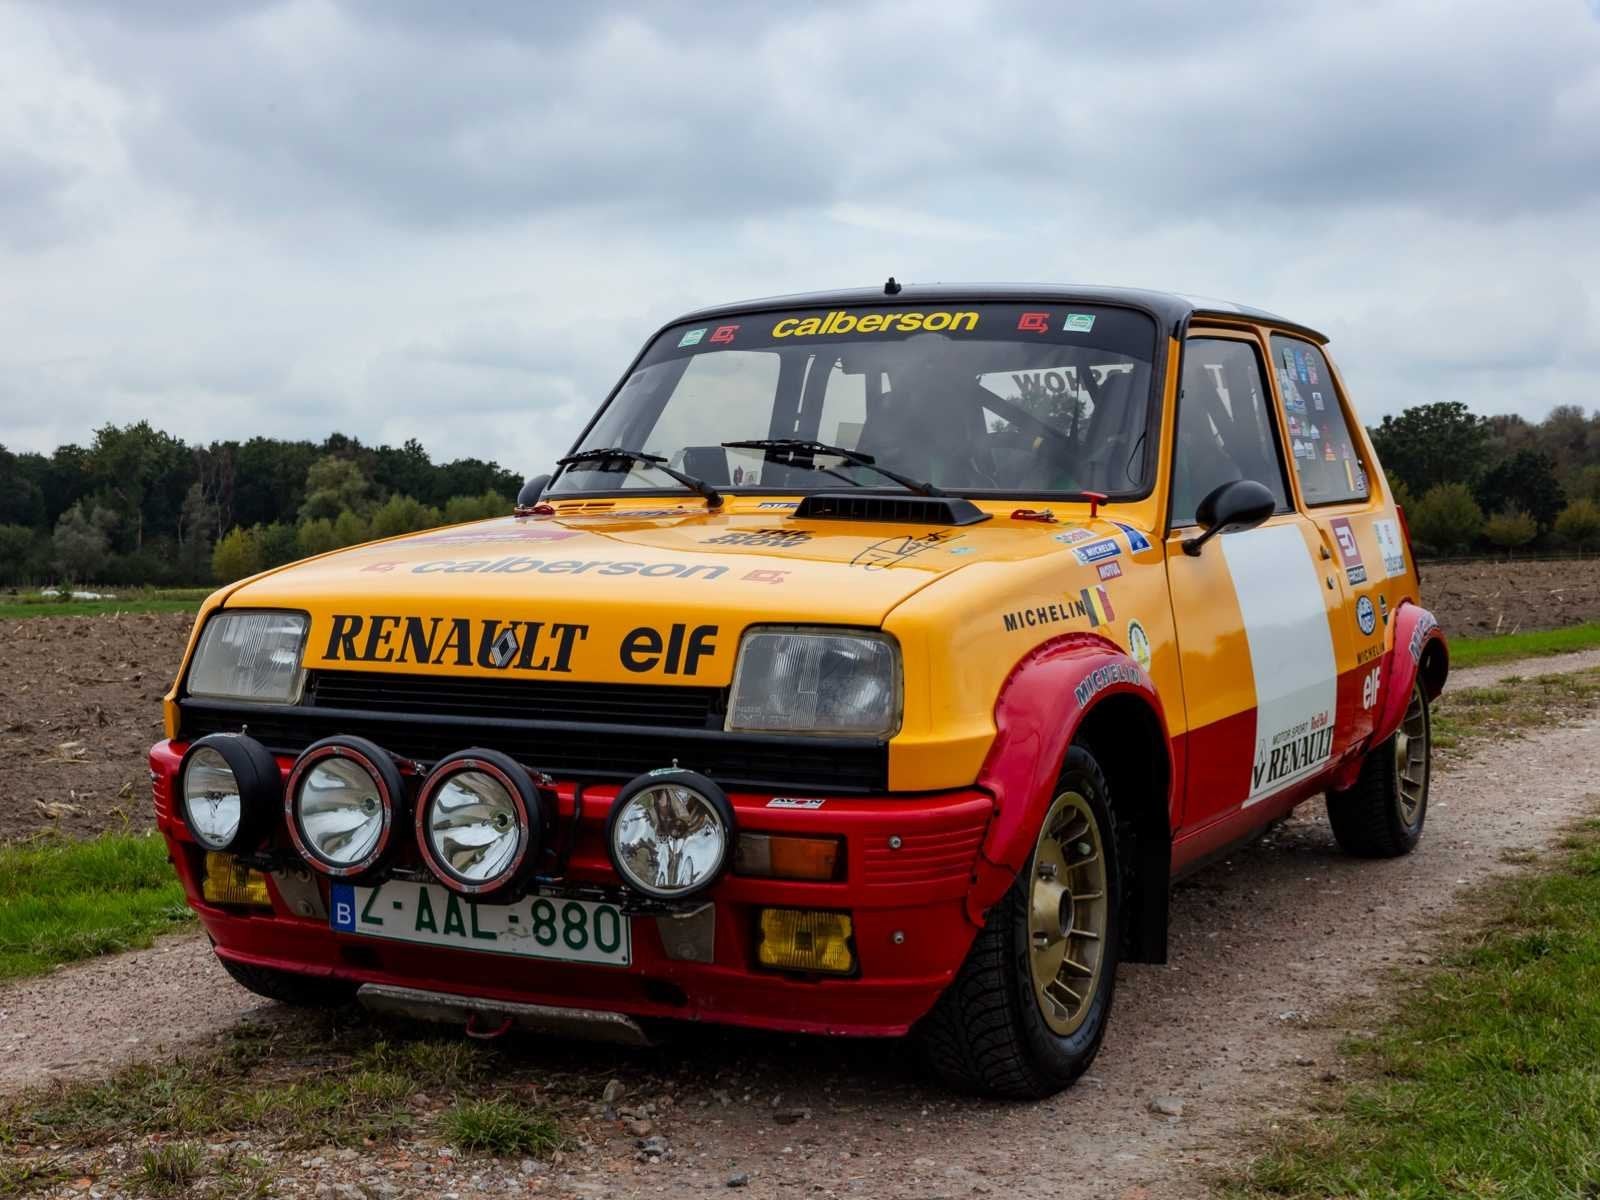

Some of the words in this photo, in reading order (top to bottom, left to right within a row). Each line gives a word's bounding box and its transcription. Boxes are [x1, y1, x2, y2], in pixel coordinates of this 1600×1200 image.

[772, 311, 980, 339] calberson
[411, 556, 730, 580] calberson
[1003, 600, 1087, 631] MICHELIN
[321, 614, 589, 673] RENAULT
[619, 623, 719, 676] elf
[1075, 663, 1141, 708] MICHELIN
[1363, 666, 1380, 710] elf
[1266, 726, 1334, 783] RENAULT
[336, 903, 352, 925] B
